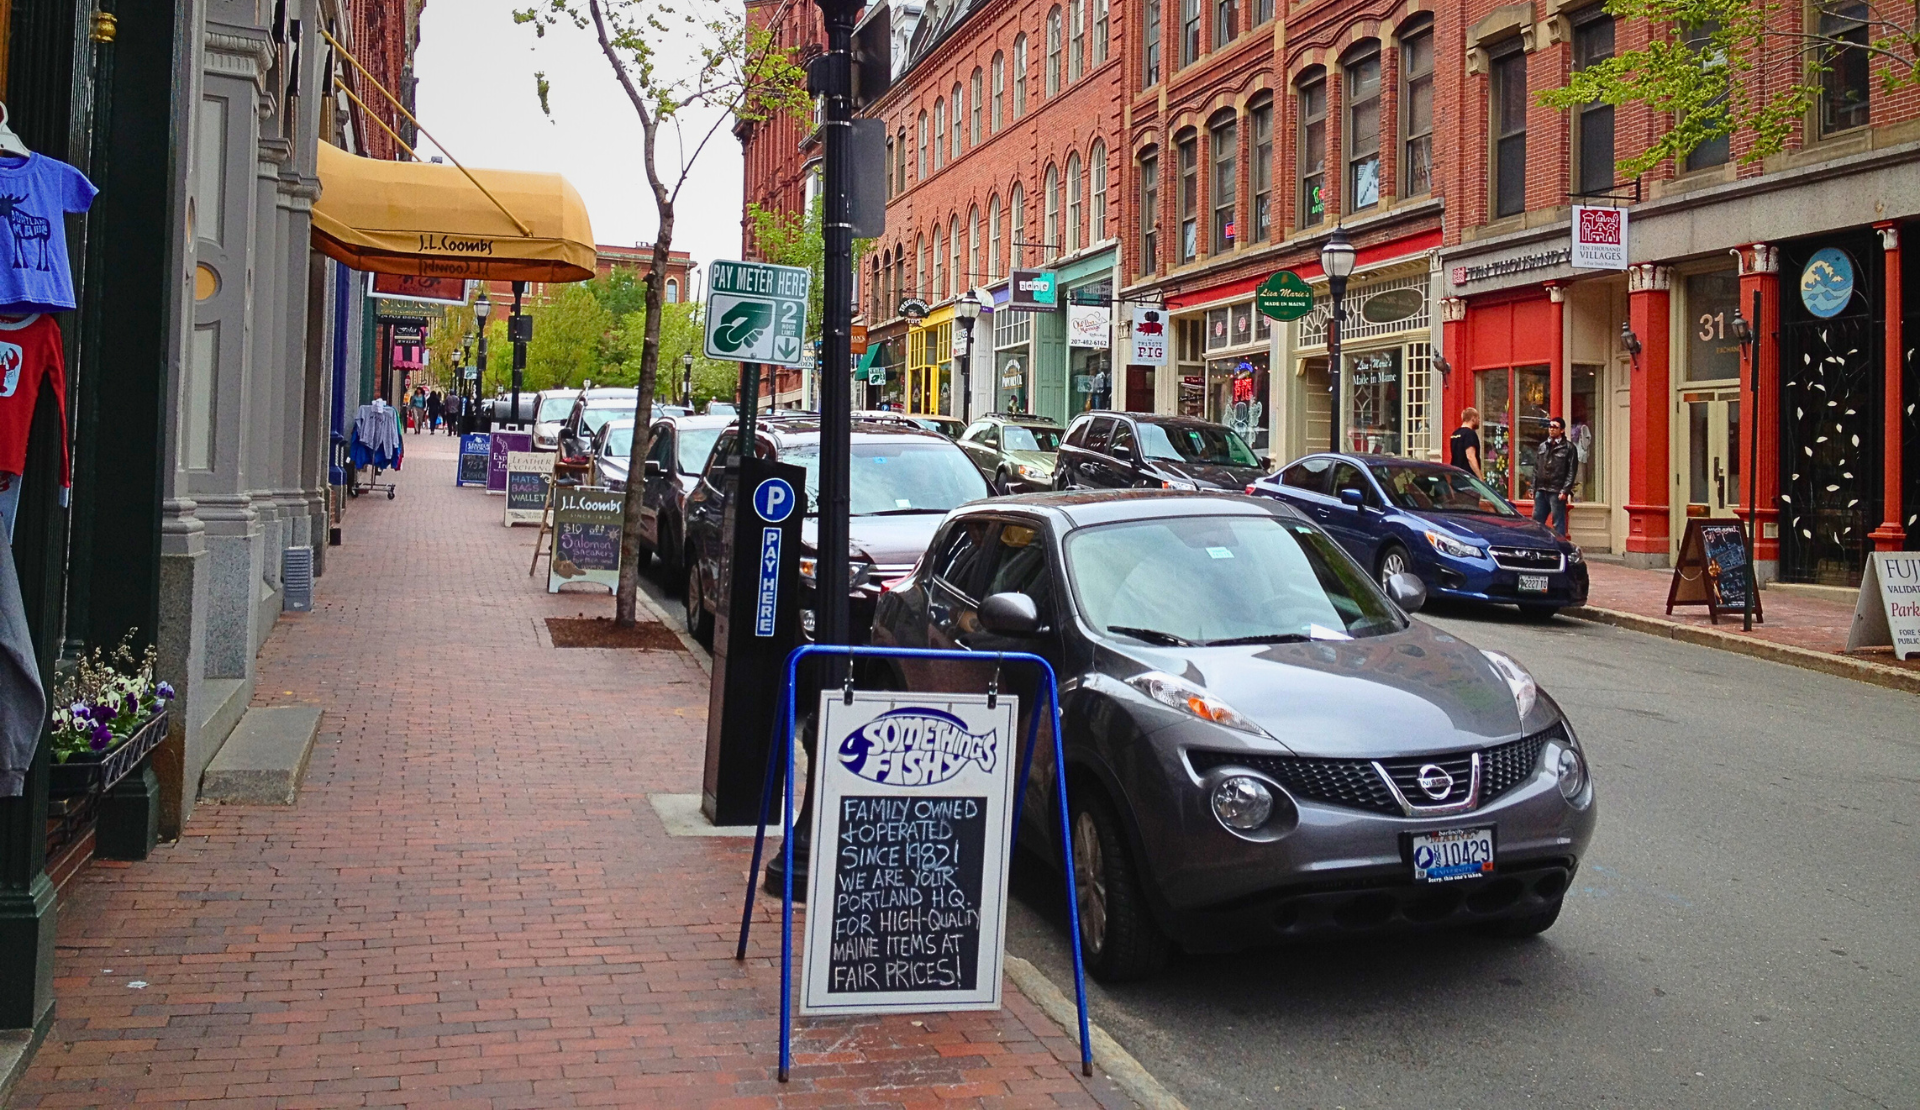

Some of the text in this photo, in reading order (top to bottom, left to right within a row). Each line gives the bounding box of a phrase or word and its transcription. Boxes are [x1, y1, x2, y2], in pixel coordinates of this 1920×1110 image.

[418, 234, 493, 255] J.L.Coombs
[1492, 250, 1561, 275] THOUSAND
[1579, 251, 1622, 261] VILLAGES
[712, 264, 806, 297] PAY METER HERE
[1259, 288, 1310, 298] Lisa Marie's
[781, 302, 798, 324] 2
[898, 298, 931, 314] TREEHOUSE
[1699, 312, 1724, 341] 31
[1137, 347, 1163, 358] PIG
[493, 453, 507, 461] Exp
[508, 463, 551, 472] EXCHANG
[512, 456, 551, 465] LEATHER
[511, 475, 539, 484] HATS
[511, 484, 540, 493] BAGS
[560, 495, 622, 514] J.L.Coombs
[561, 533, 612, 549] Salomon
[765, 532, 778, 573] PAY
[760, 578, 775, 632] HERE
[1898, 637, 1920, 645] PUBLIC
[860, 749, 970, 785] FISHY
[844, 797, 978, 822] FAMILY OWNED
[841, 840, 959, 871] SINCE 1982!
[839, 866, 958, 893] WE ARE YOUR
[837, 888, 923, 914] PORTLAND
[835, 914, 875, 941] FOR
[833, 932, 964, 961] MAINE ITEMS AT
[834, 955, 962, 991] FAIR PRICES!
